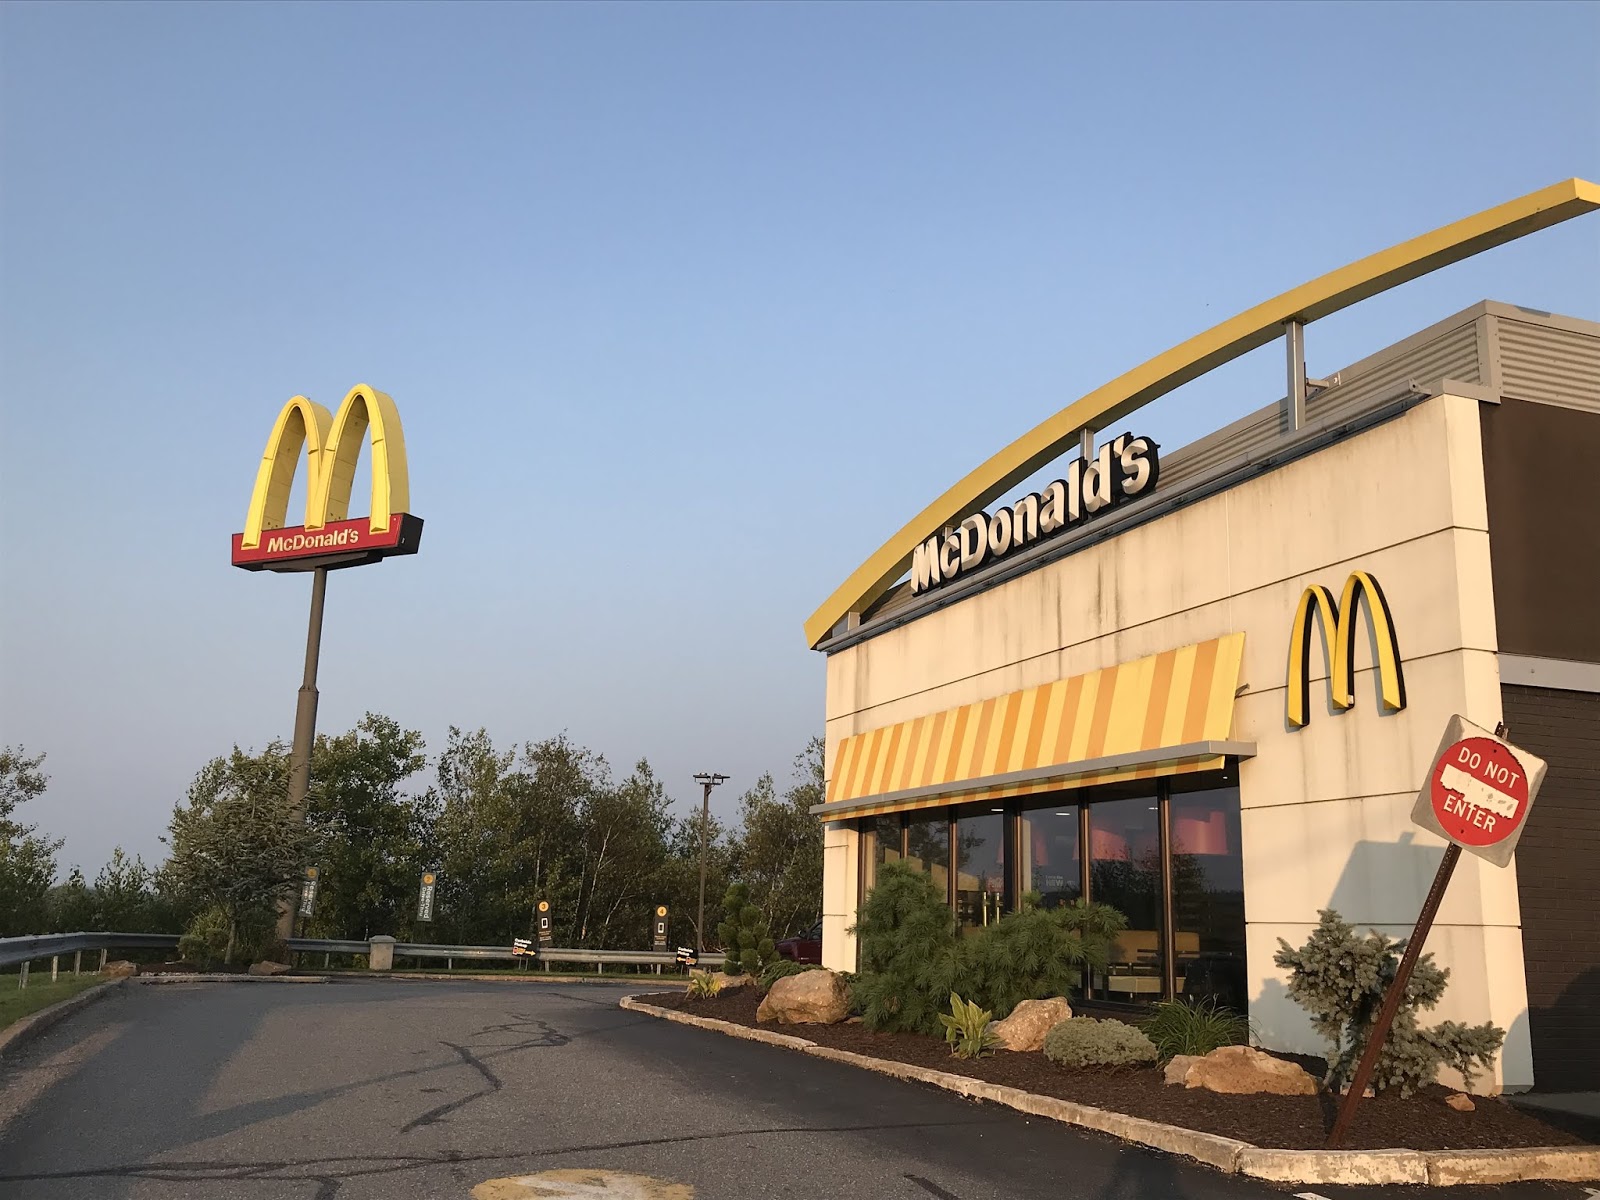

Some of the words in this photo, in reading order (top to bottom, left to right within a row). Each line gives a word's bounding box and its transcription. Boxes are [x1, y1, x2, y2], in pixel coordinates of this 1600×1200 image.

[910, 433, 1156, 596] McDonald's
[267, 528, 359, 553] McDonald's
[1458, 747, 1481, 769] DO
[1484, 761, 1520, 789] NOT
[1443, 794, 1496, 833] ENTER
[423, 886, 433, 919] Reserved
